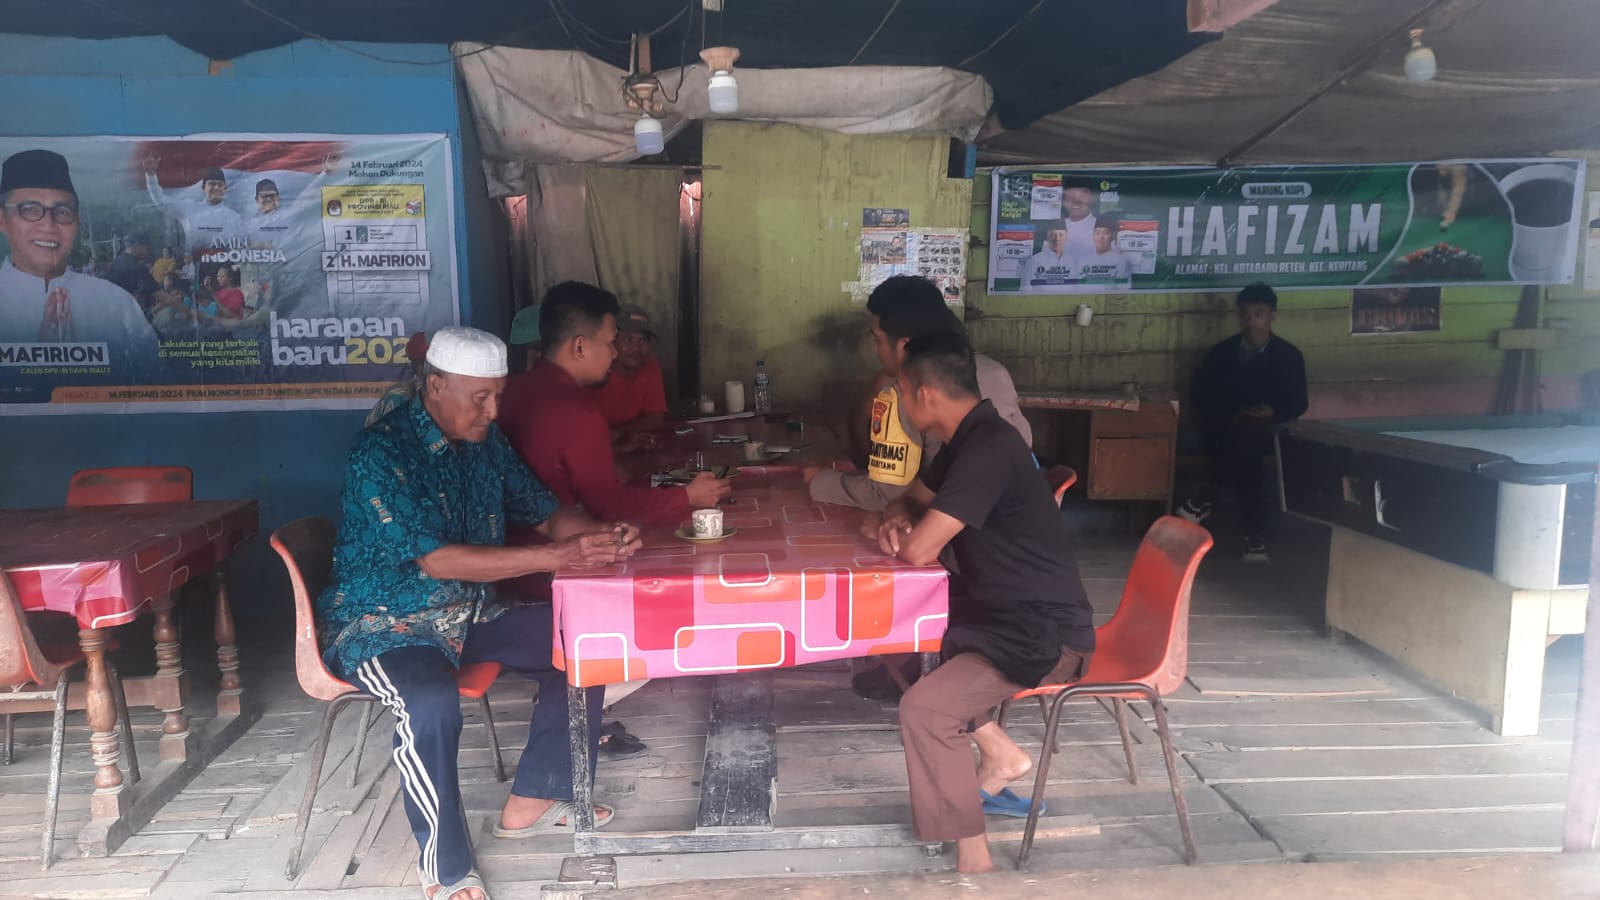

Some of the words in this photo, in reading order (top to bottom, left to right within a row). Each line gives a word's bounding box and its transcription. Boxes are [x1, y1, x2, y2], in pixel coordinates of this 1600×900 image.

[1166, 203, 1382, 257] HAFIZAM
[201, 249, 286, 263] INDONESIA
[326, 256, 335, 267] 2
[341, 255, 356, 267] H.
[358, 254, 426, 267] MAFIRION
[270, 311, 405, 343] harapan
[158, 340, 199, 348] Lakukan
[200, 341, 224, 349] yang
[225, 339, 259, 348] terbaik
[0, 346, 104, 363] MAFIRION
[190, 359, 215, 368] yang
